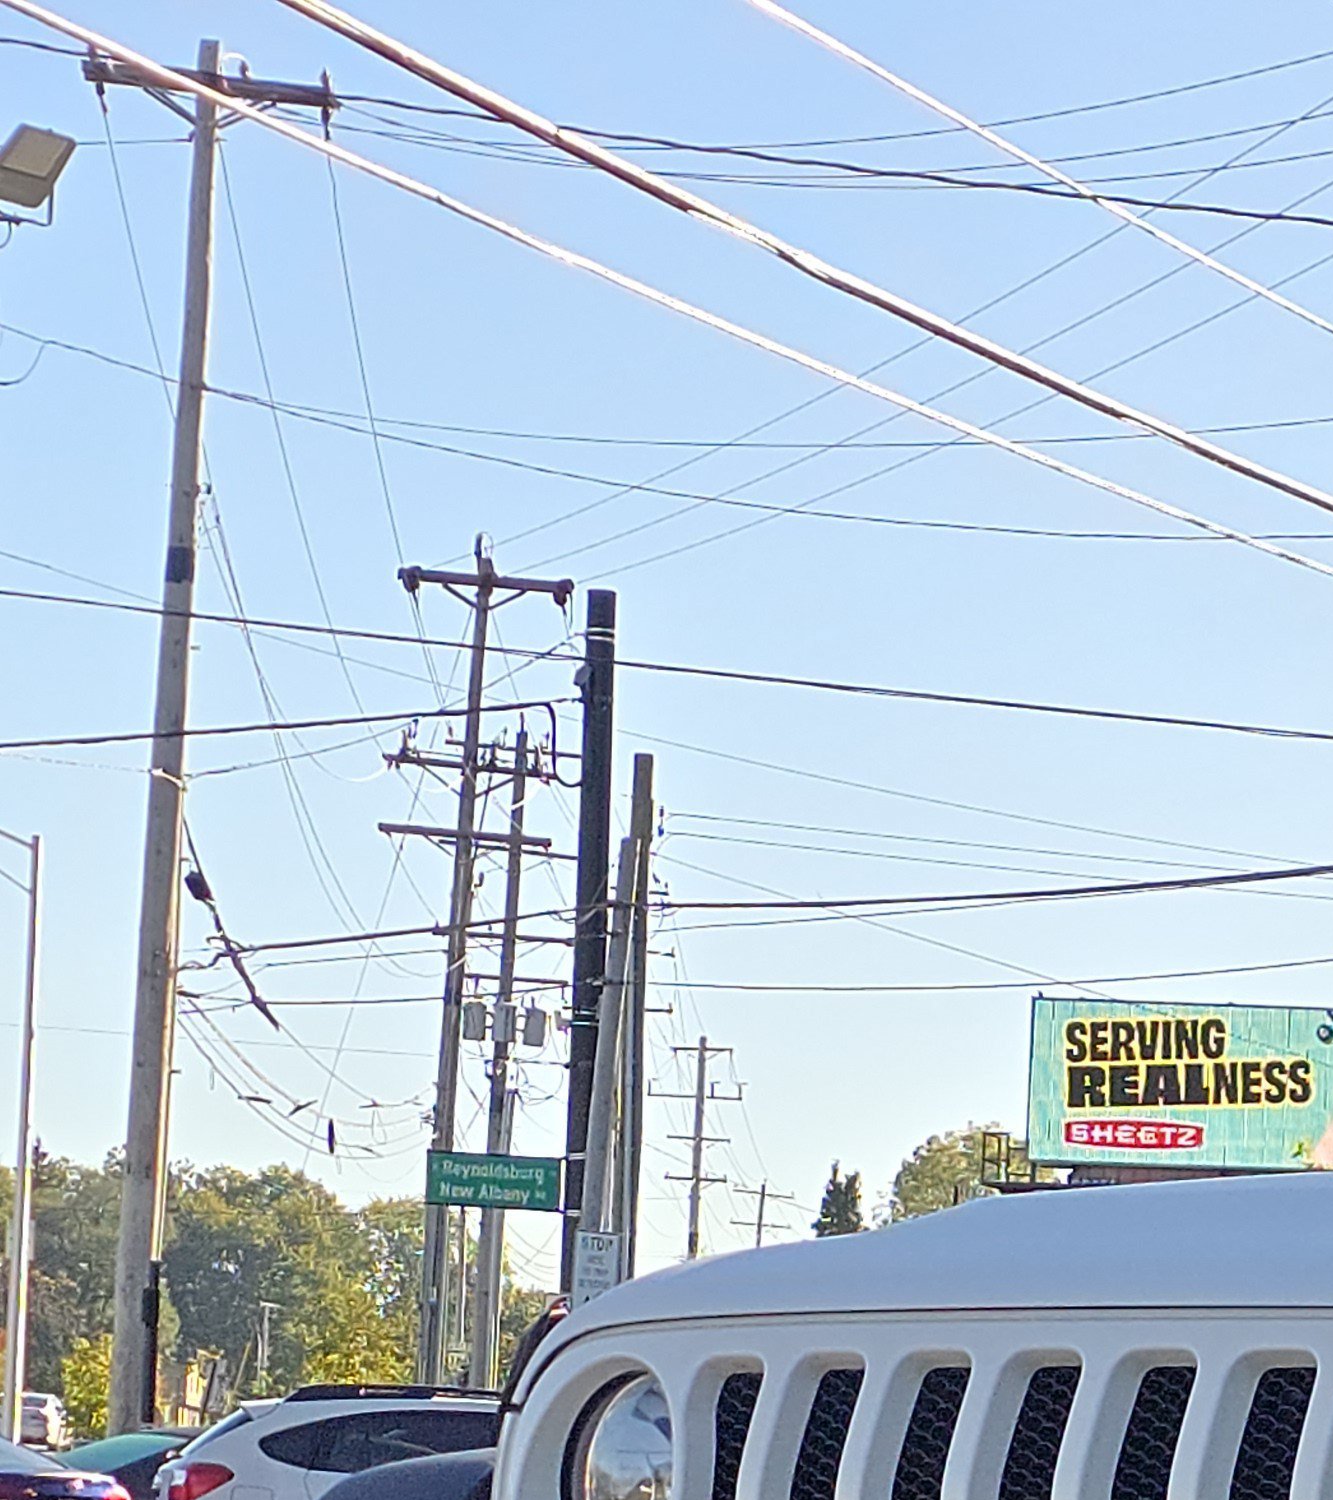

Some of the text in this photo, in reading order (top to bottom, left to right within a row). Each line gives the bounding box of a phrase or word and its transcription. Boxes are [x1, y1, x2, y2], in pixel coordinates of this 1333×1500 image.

[1065, 1018, 1226, 1062] SERVING
[1067, 1059, 1312, 1107] REALNESS
[1071, 1123, 1198, 1146] SHEETZ
[442, 1160, 545, 1185] Reynoldsburg
[440, 1181, 474, 1198] New
[478, 1183, 530, 1205] Albany
